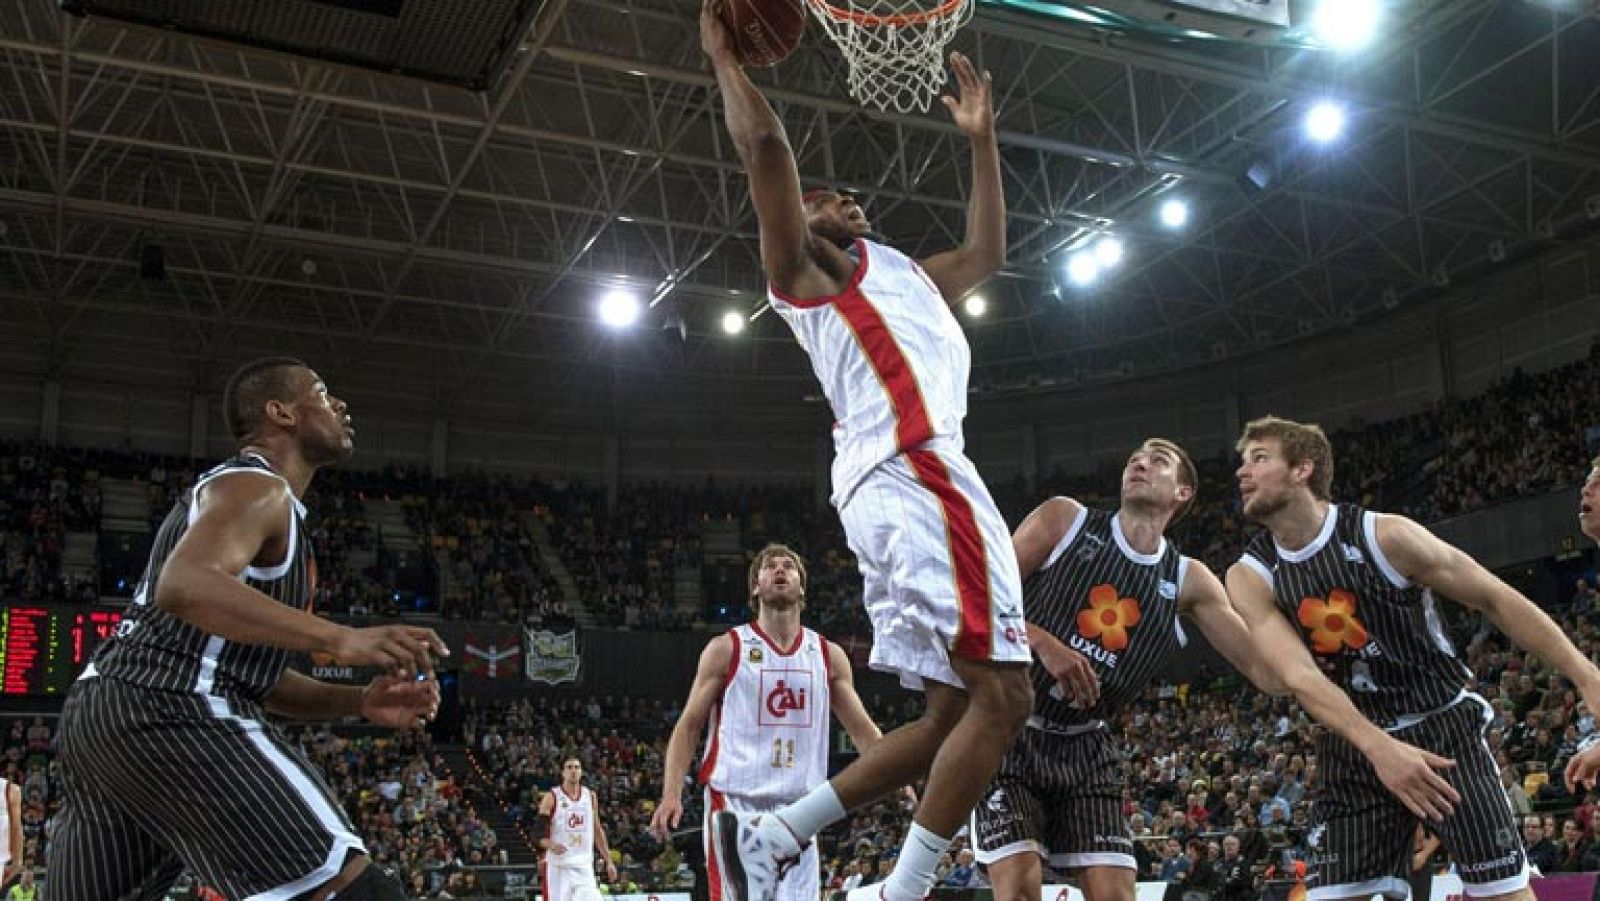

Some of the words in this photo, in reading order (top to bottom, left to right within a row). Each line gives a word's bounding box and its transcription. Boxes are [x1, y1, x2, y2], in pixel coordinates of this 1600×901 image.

[1070, 634, 1117, 669] UXUE
[312, 666, 353, 679] UXUE
[772, 737, 796, 769] 11
